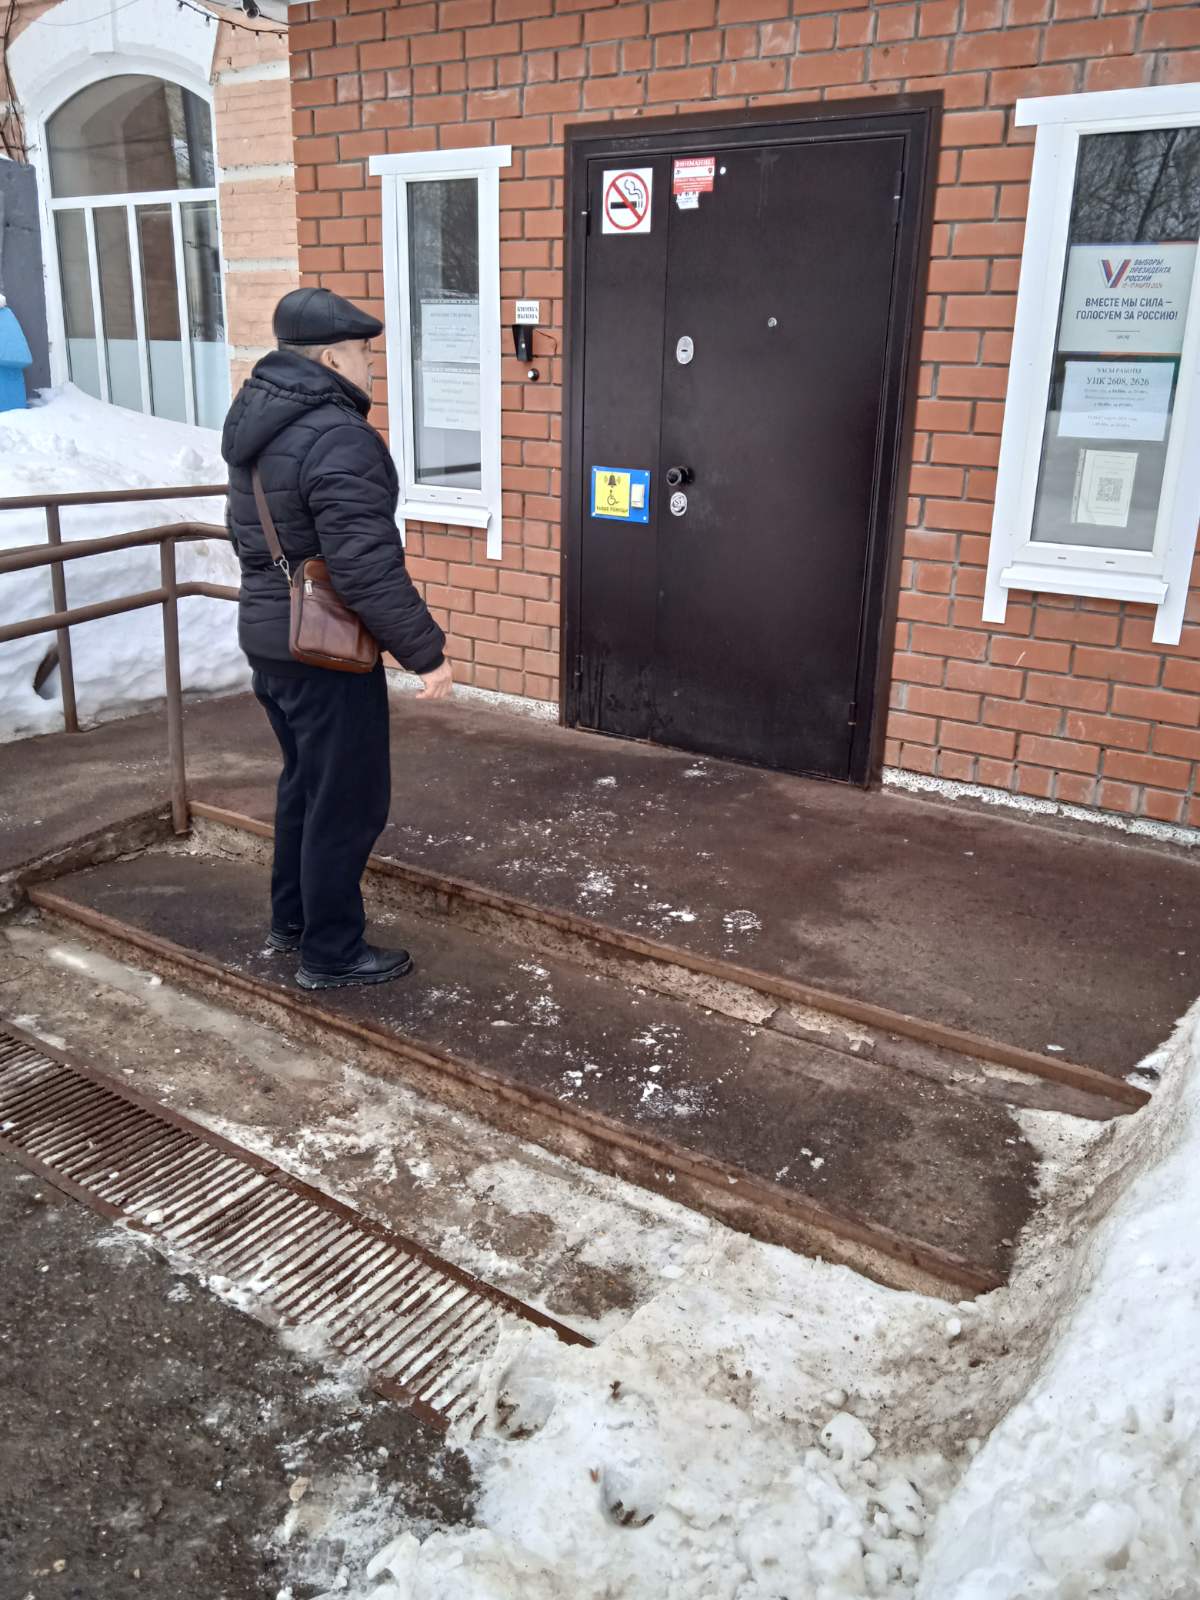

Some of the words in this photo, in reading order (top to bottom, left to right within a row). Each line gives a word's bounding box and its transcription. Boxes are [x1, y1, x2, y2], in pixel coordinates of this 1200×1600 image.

[1085, 298, 1119, 307] ВМЕСТЕ
[1121, 298, 1137, 307] МЫ
[1139, 298, 1164, 307] СИЛА
[1076, 311, 1121, 320] ГОЛОСУЕМ
[1123, 311, 1134, 320] ЗА
[1136, 311, 1178, 320] РОССИЮ!
[1086, 377, 1105, 385] УИК
